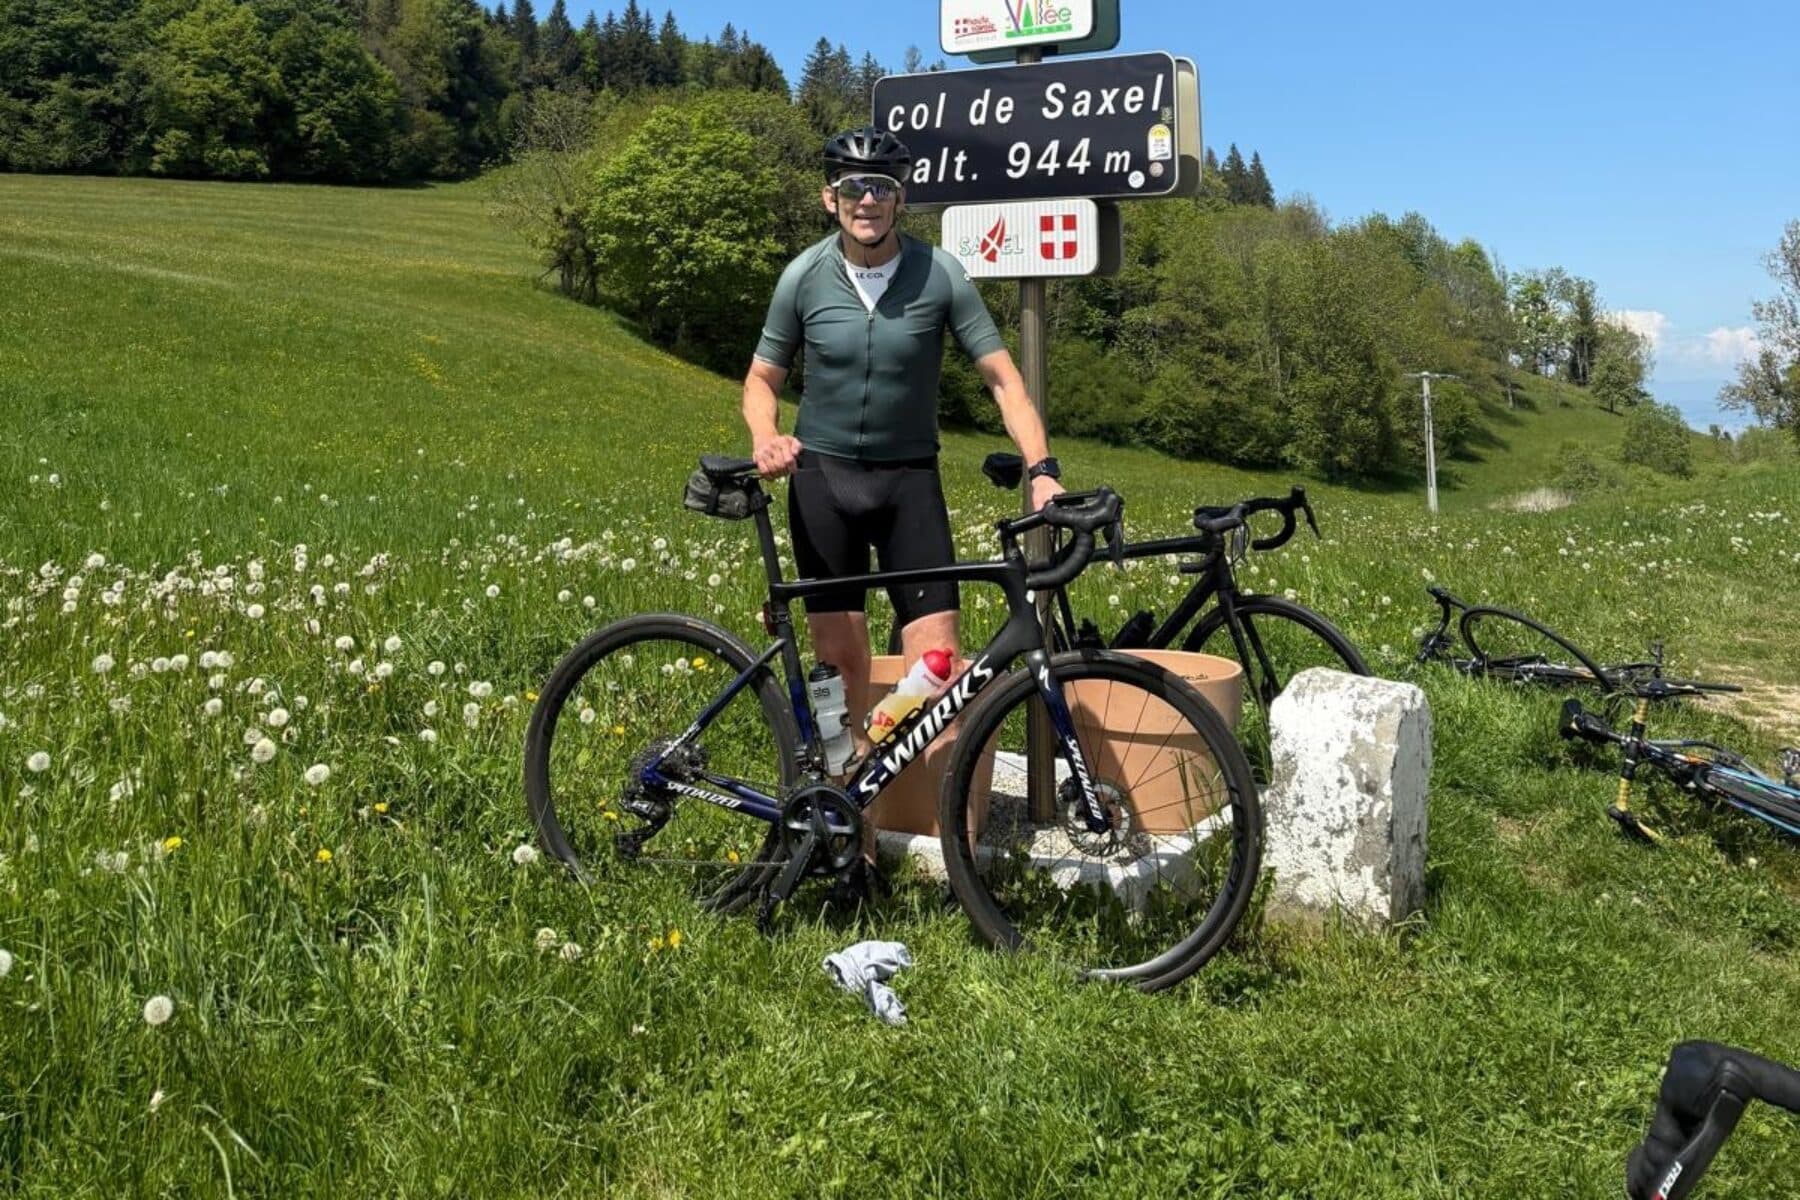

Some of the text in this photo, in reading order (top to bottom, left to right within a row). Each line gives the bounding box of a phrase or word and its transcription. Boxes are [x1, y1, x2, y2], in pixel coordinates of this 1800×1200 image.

[887, 73, 1164, 132] col de Saxel
[912, 137, 1131, 184] alt. 944 m
[858, 654, 994, 801] S-WORKS
